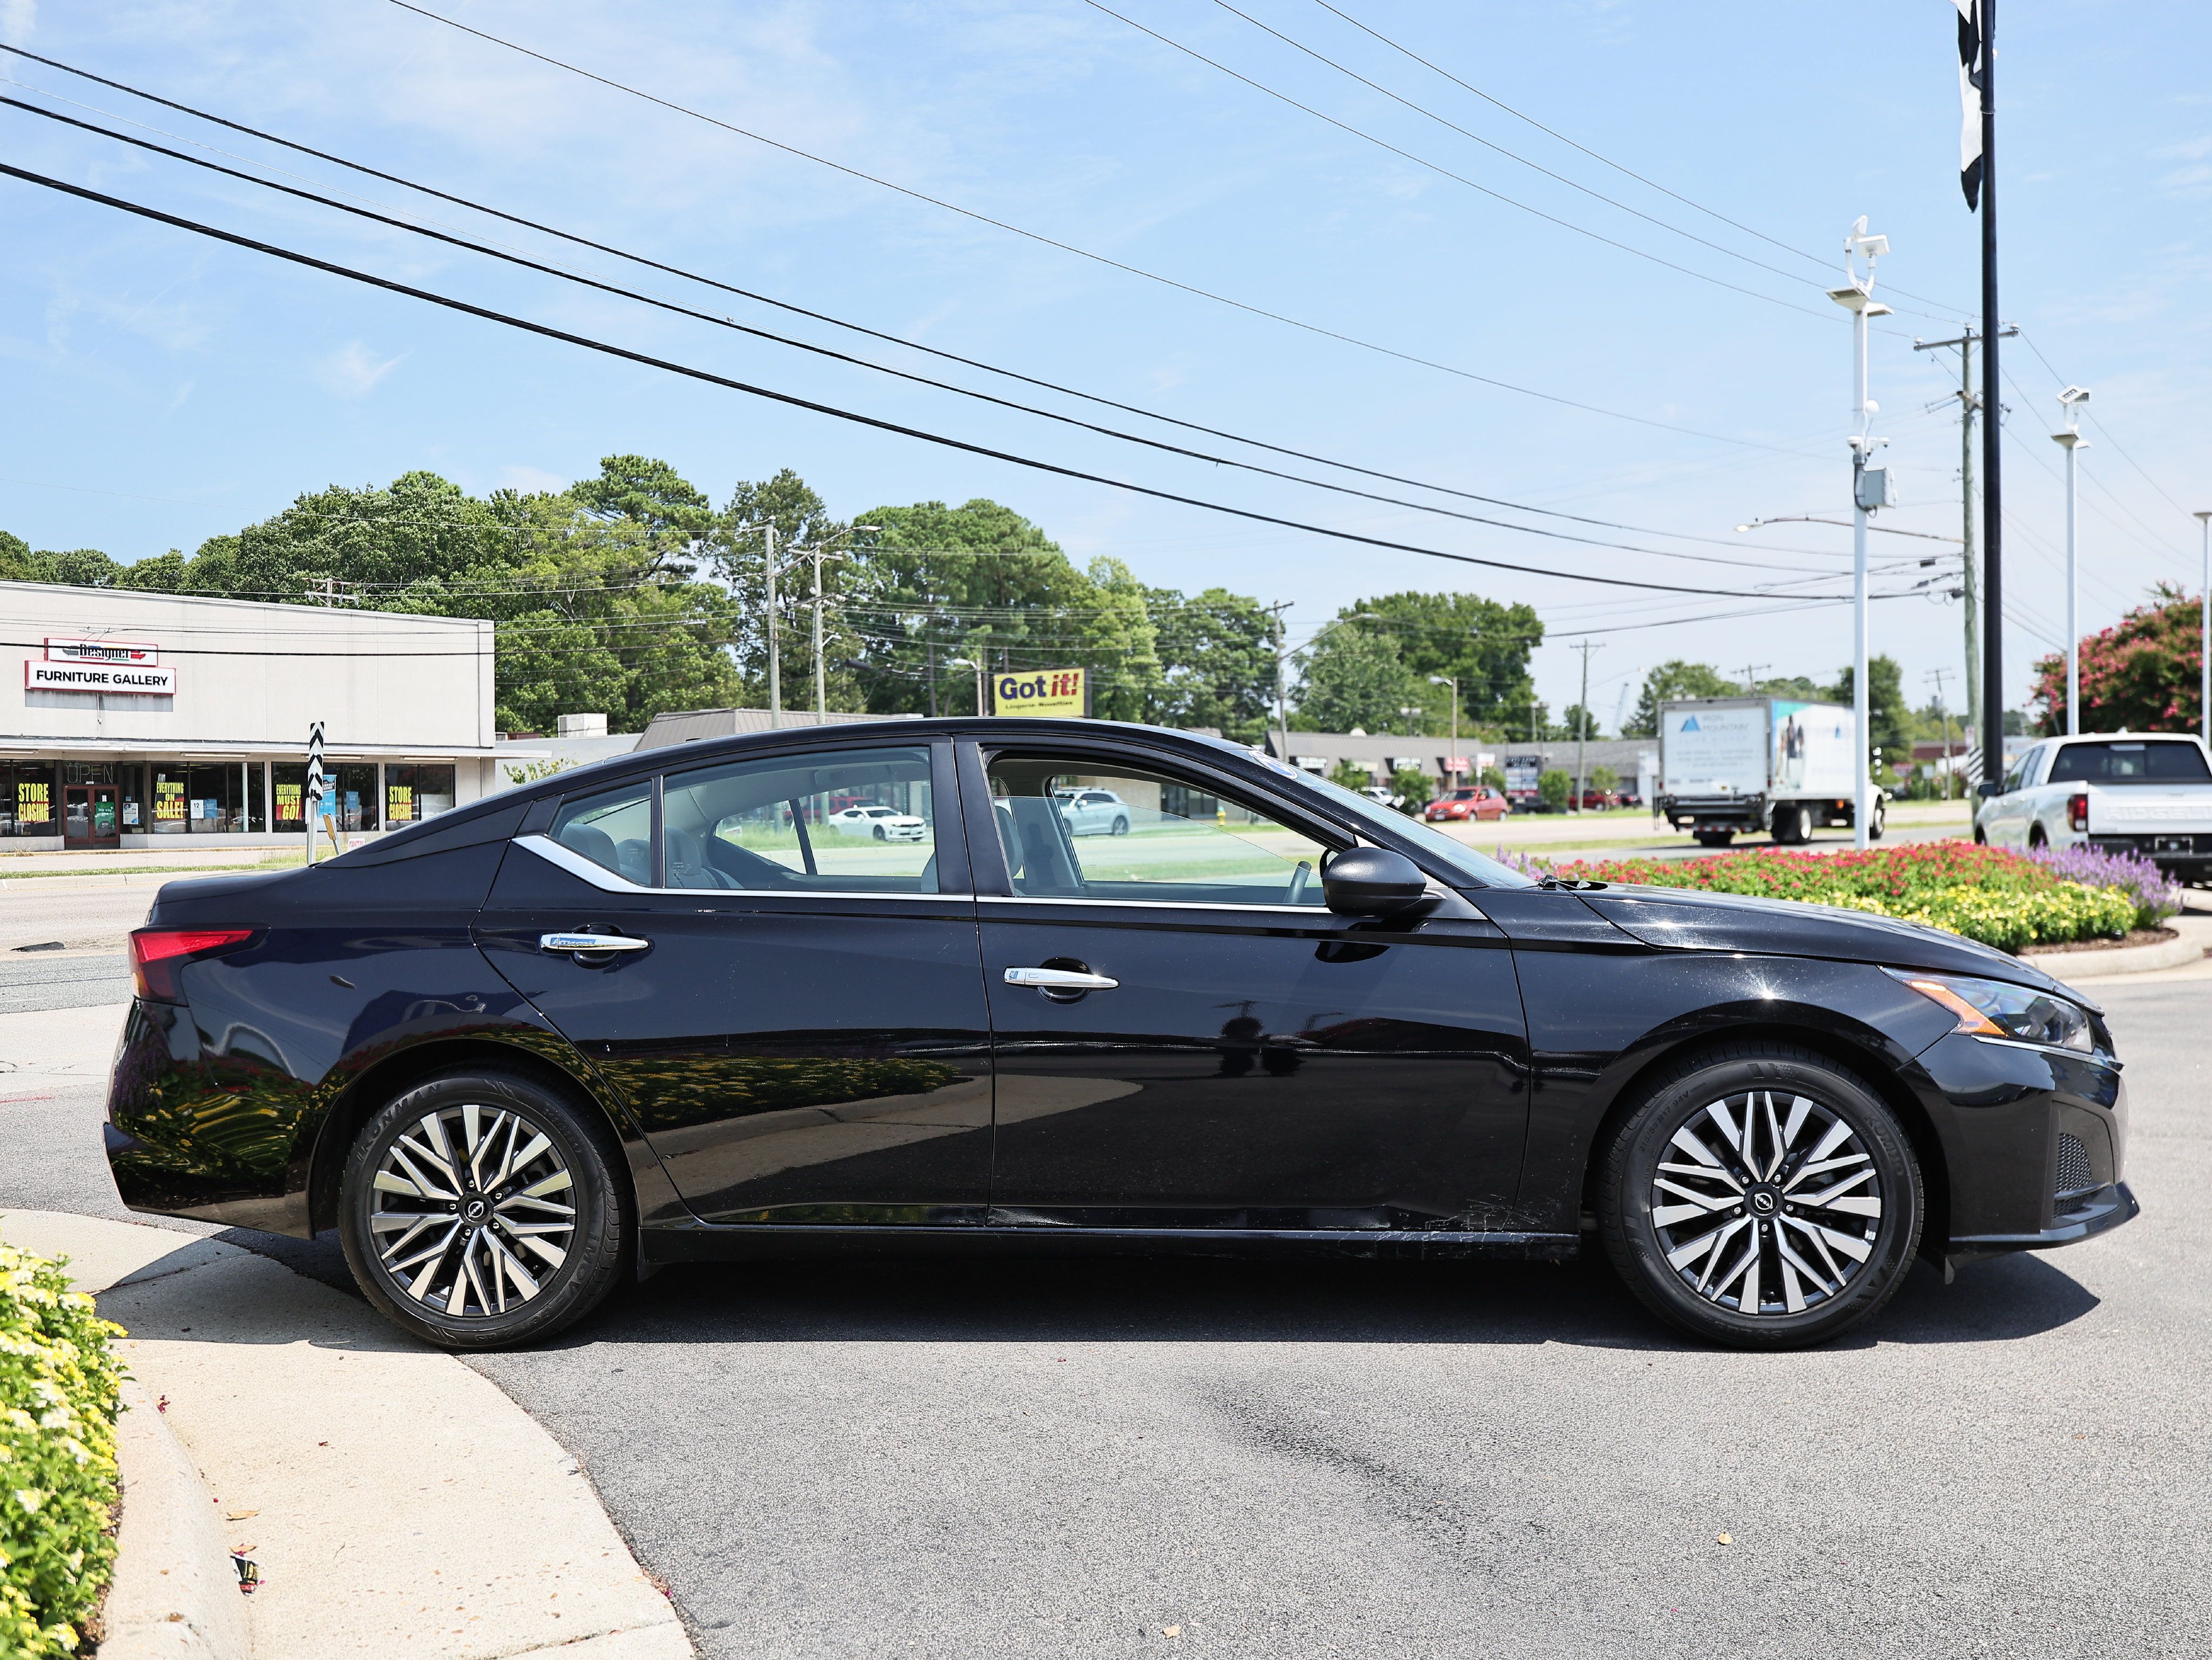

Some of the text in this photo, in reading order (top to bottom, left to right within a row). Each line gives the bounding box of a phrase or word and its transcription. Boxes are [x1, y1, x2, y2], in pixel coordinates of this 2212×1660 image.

[79, 644, 129, 660] Designer
[36, 670, 168, 686] FURNITURE GALLERY
[1000, 673, 1079, 699] Got it!
[68, 764, 113, 784] OPEN
[18, 783, 49, 802] STORE
[157, 781, 184, 794] EVERYTHING
[276, 784, 301, 795] EVERYTHING
[389, 786, 412, 804] STORE
[165, 793, 175, 801] ON
[276, 795, 301, 805] MUST
[18, 803, 49, 821] CLOSING
[156, 800, 184, 819] SALE!
[282, 805, 300, 820] GO!
[389, 803, 412, 820] CLOSING
[2105, 807, 2212, 820] RIDGELI
[1673, 1091, 1689, 1106] 94V
[1863, 1115, 1904, 1177] KUMHO
